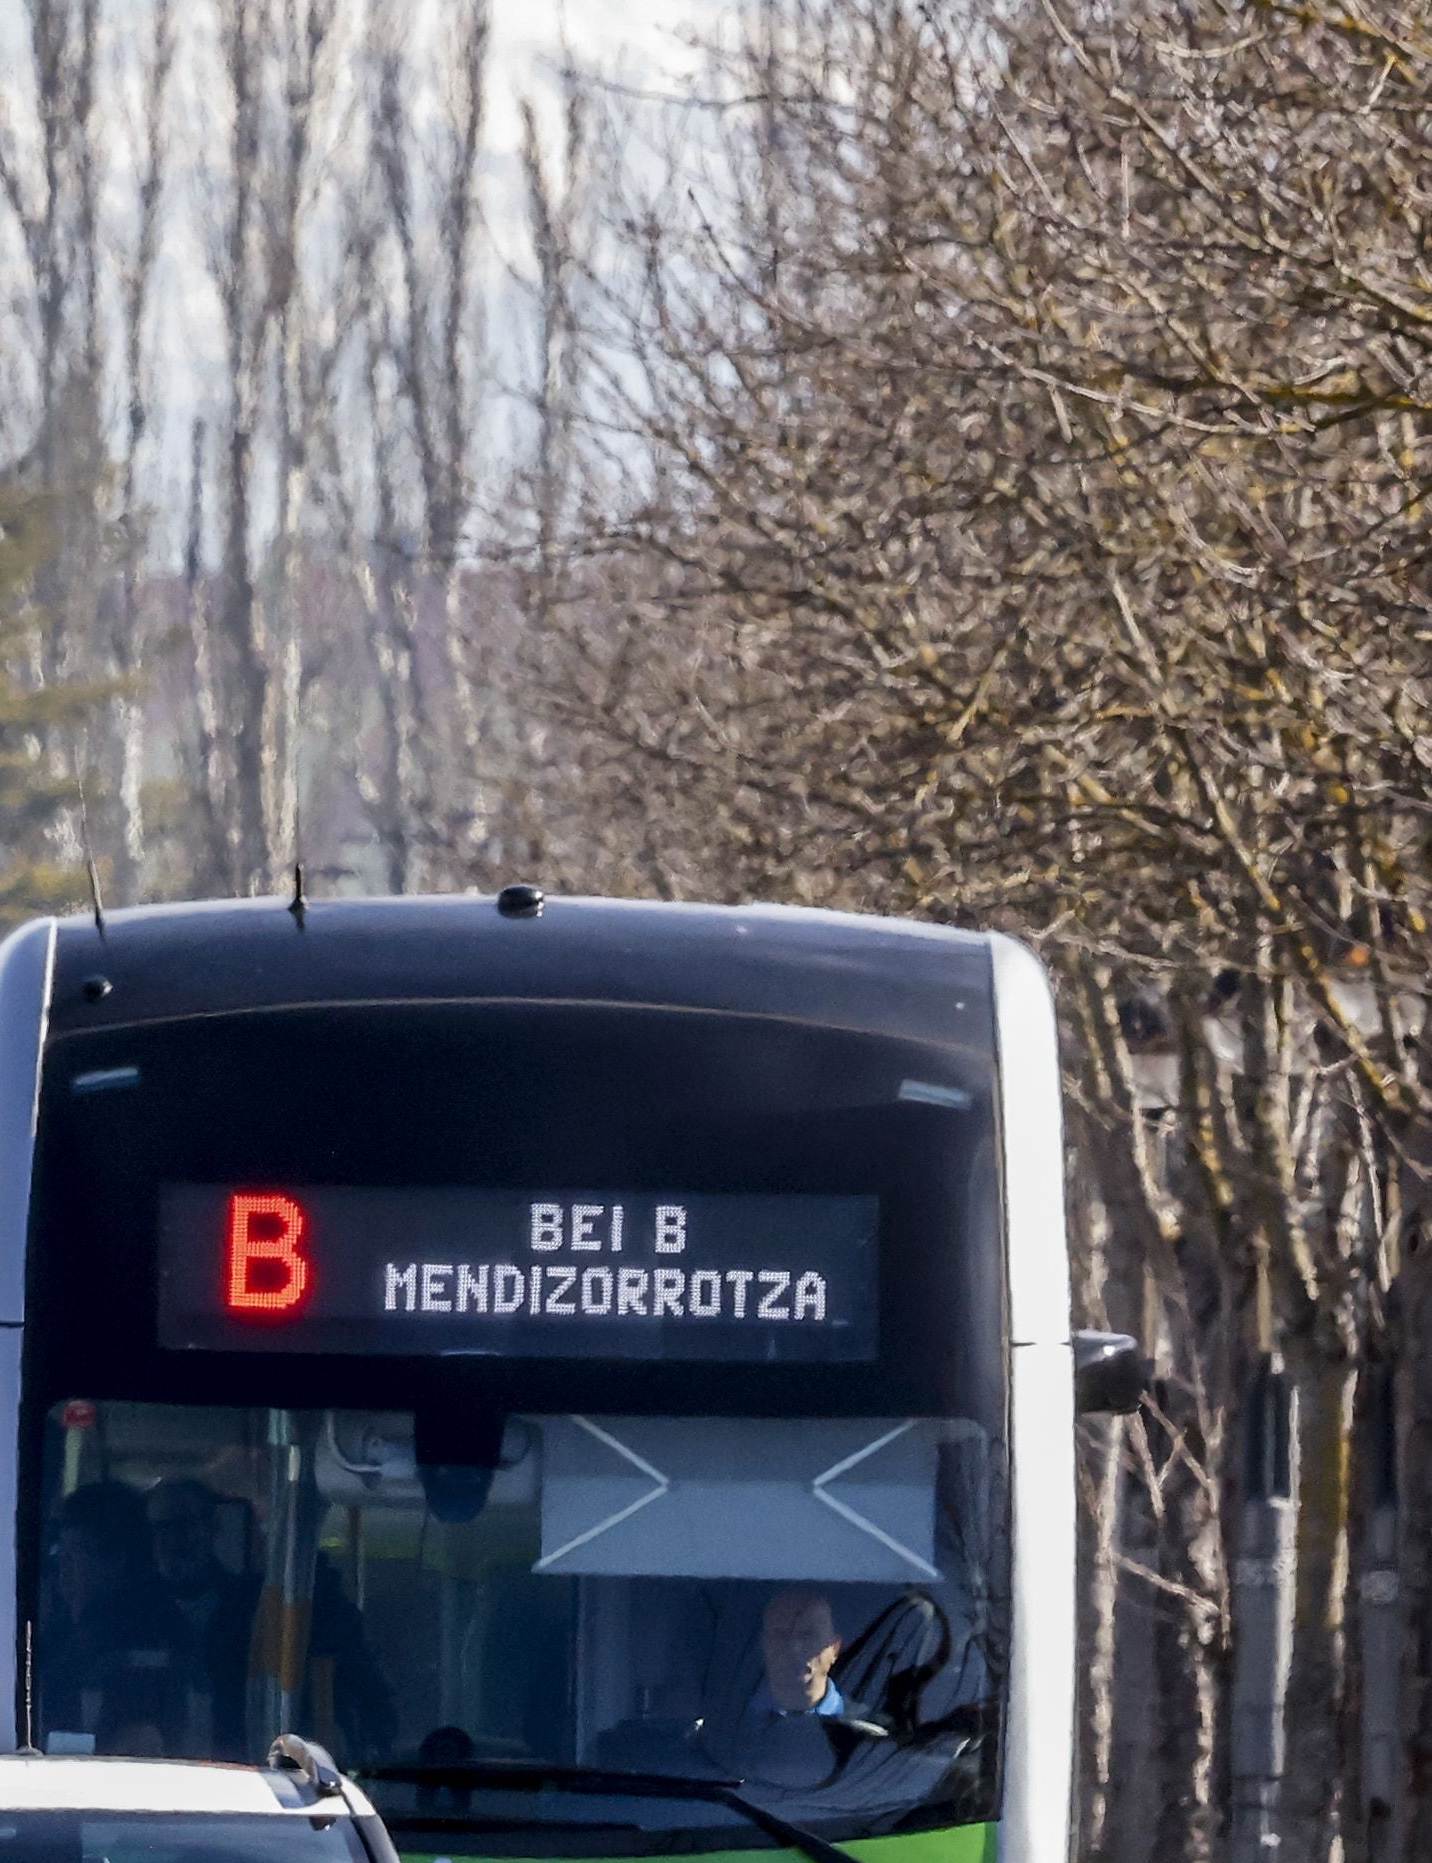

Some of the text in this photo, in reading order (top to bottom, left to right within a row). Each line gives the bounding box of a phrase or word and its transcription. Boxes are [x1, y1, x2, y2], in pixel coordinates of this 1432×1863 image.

[229, 1195, 306, 1310] B
[530, 1203, 687, 1254] BEI B
[384, 1262, 828, 1321] MENDIZORROTZA
